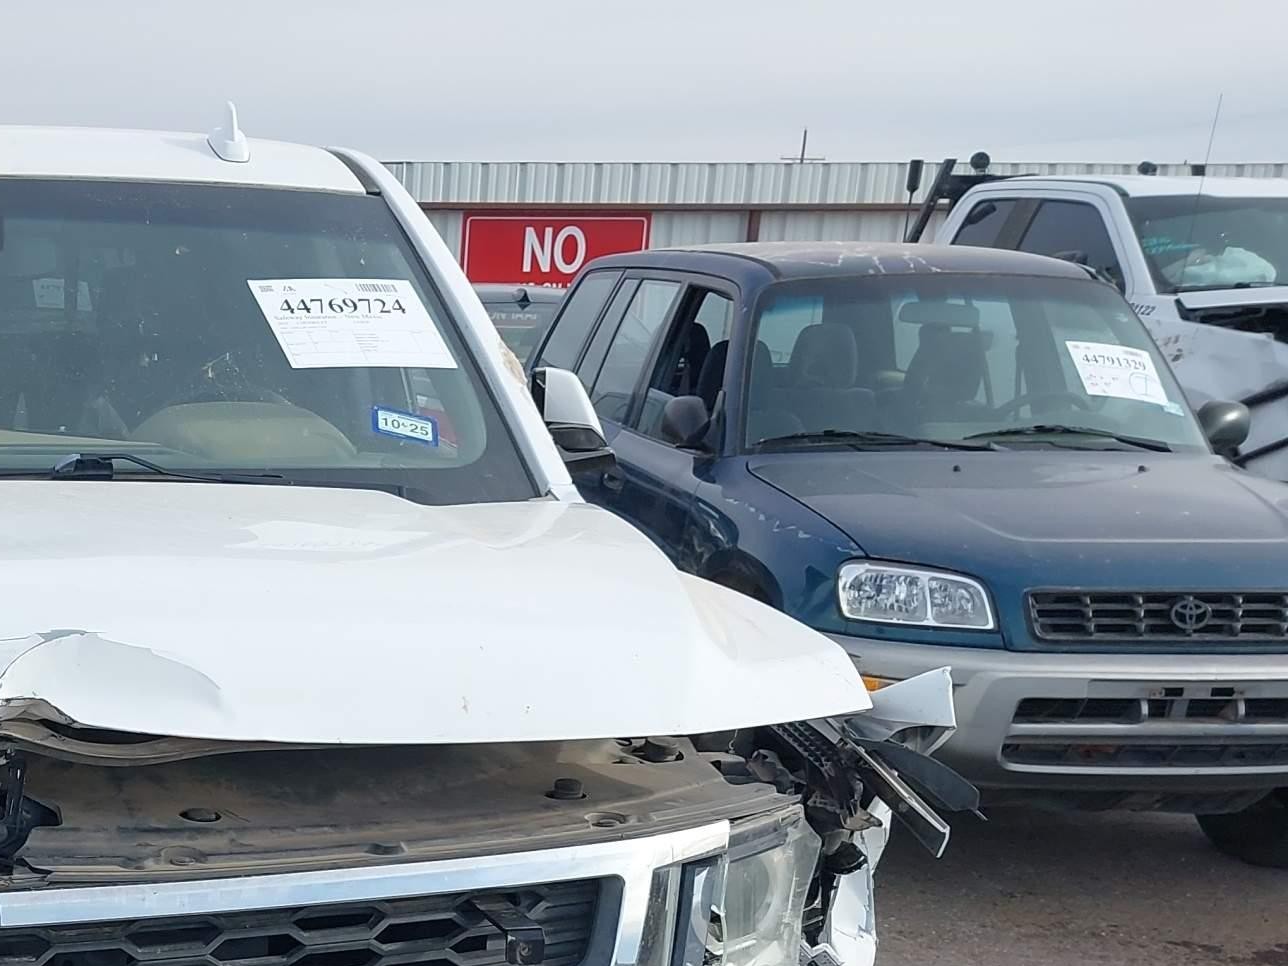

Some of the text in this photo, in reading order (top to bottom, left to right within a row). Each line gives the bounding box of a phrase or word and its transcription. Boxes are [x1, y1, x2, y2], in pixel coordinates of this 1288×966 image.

[522, 225, 586, 274] NO
[279, 297, 406, 314] 44769724
[1082, 353, 1147, 371] 44791329
